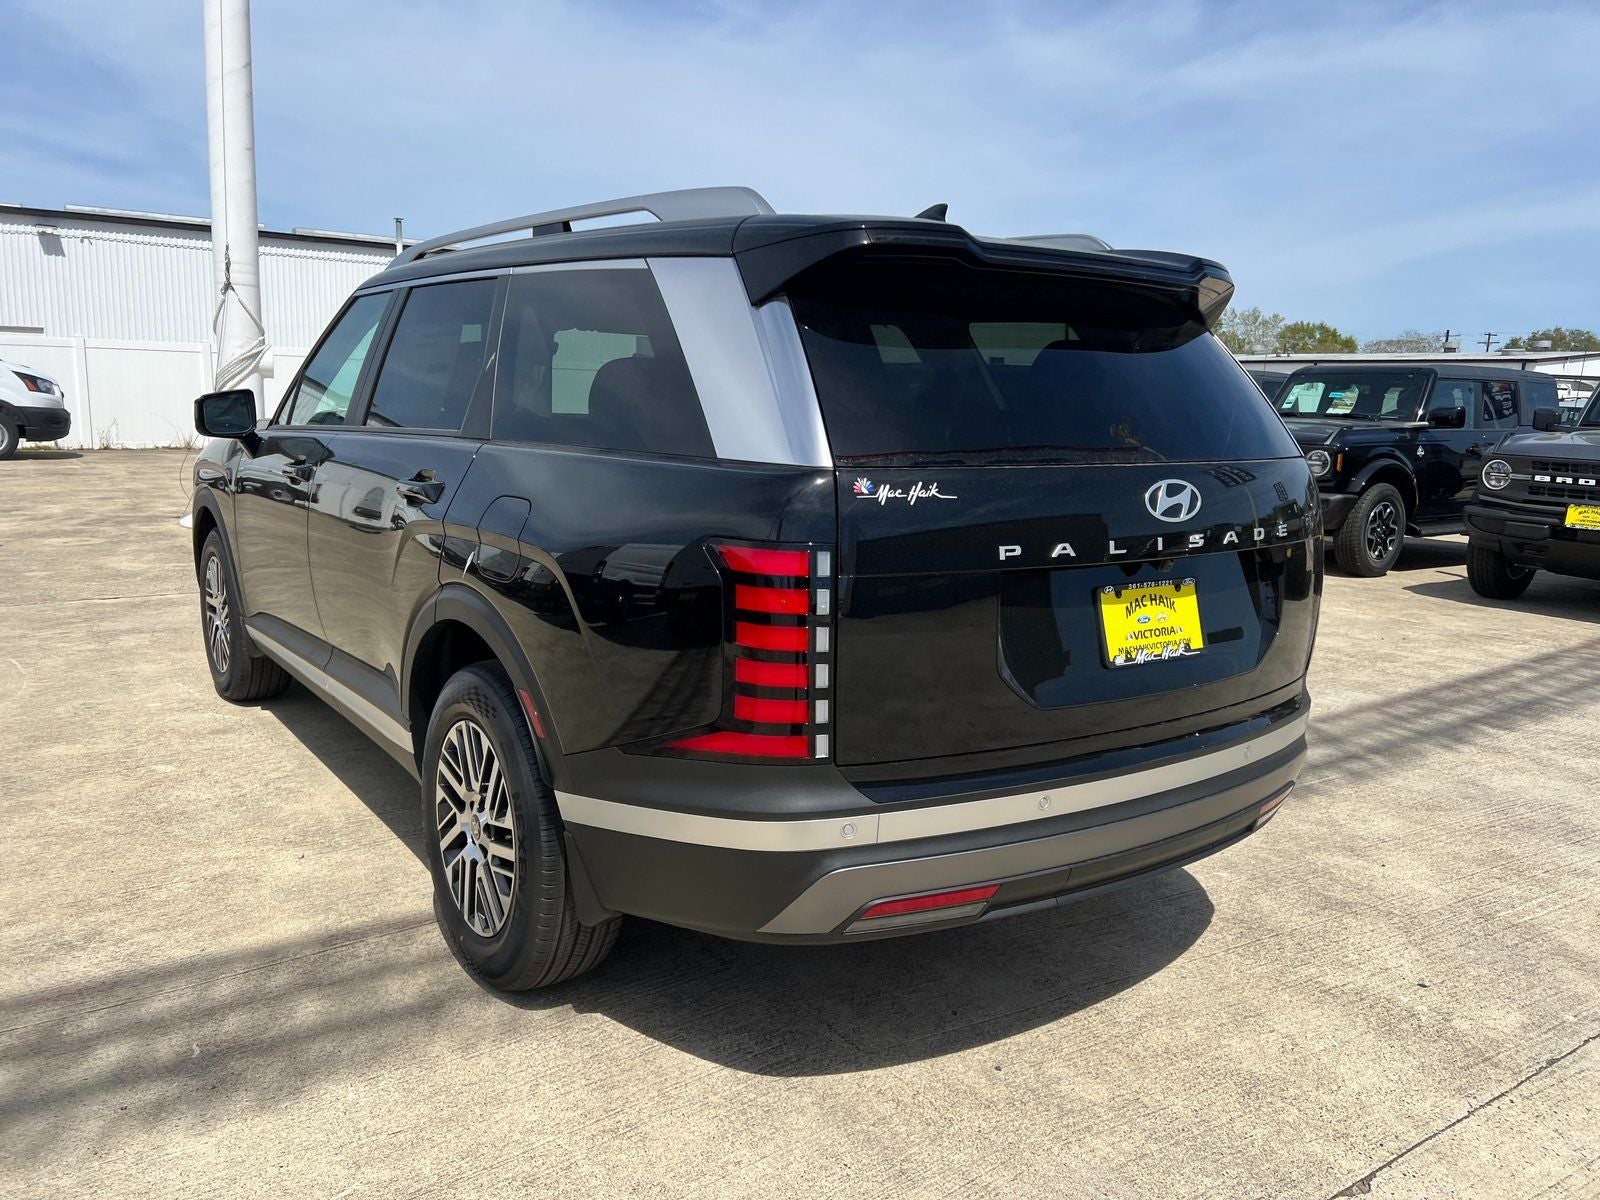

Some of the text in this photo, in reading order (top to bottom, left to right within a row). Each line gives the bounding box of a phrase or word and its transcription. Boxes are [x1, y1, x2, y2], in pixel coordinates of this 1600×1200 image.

[871, 481, 952, 506] Mac Haik
[998, 523, 1289, 561] PALISADE
[1125, 593, 1177, 618] MAC HAIK
[1133, 626, 1176, 641] VICTORIA
[1135, 649, 1162, 664] Mac
